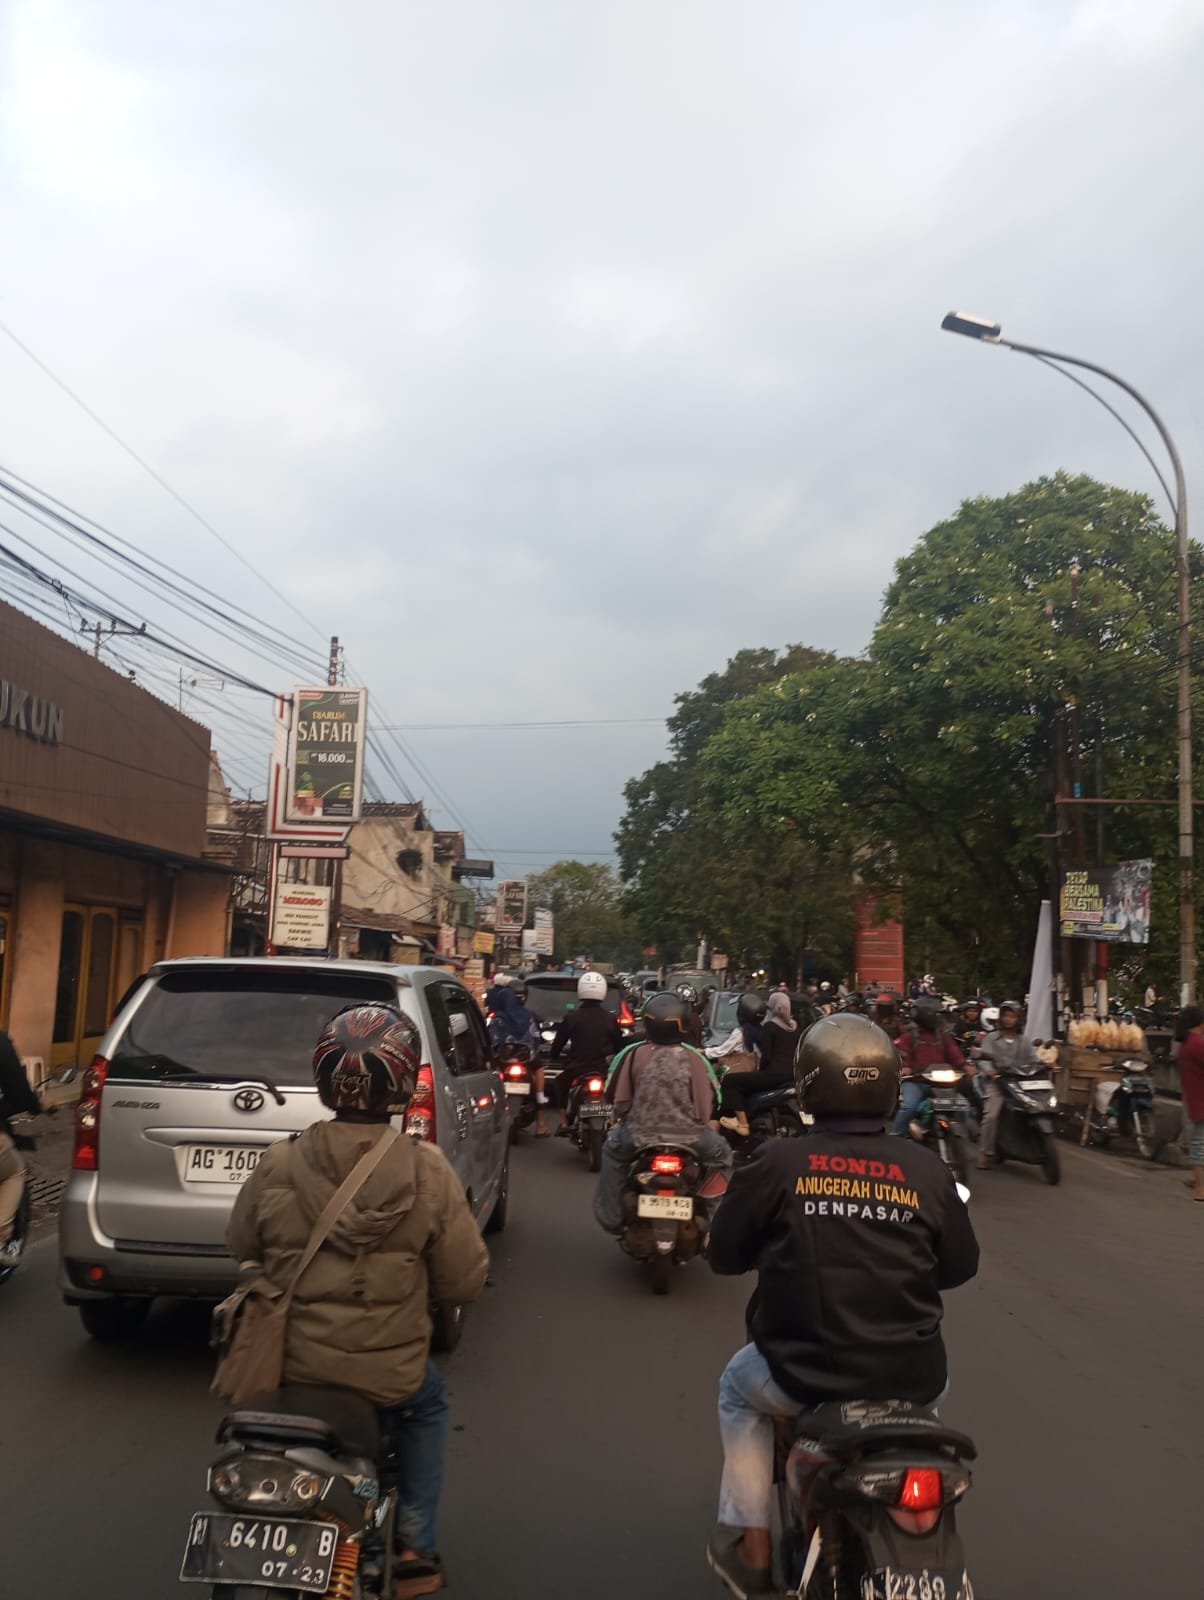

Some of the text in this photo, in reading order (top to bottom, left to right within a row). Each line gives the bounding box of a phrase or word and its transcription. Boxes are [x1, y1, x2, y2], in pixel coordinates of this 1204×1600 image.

[192, 1149, 215, 1169] AG
[808, 1154, 905, 1182] HONDA
[795, 1176, 920, 1210] ANUGERAH UTAMA
[804, 1201, 914, 1223] DENPASAR
[229, 1521, 288, 1551] 6410
[318, 1530, 333, 1557] B
